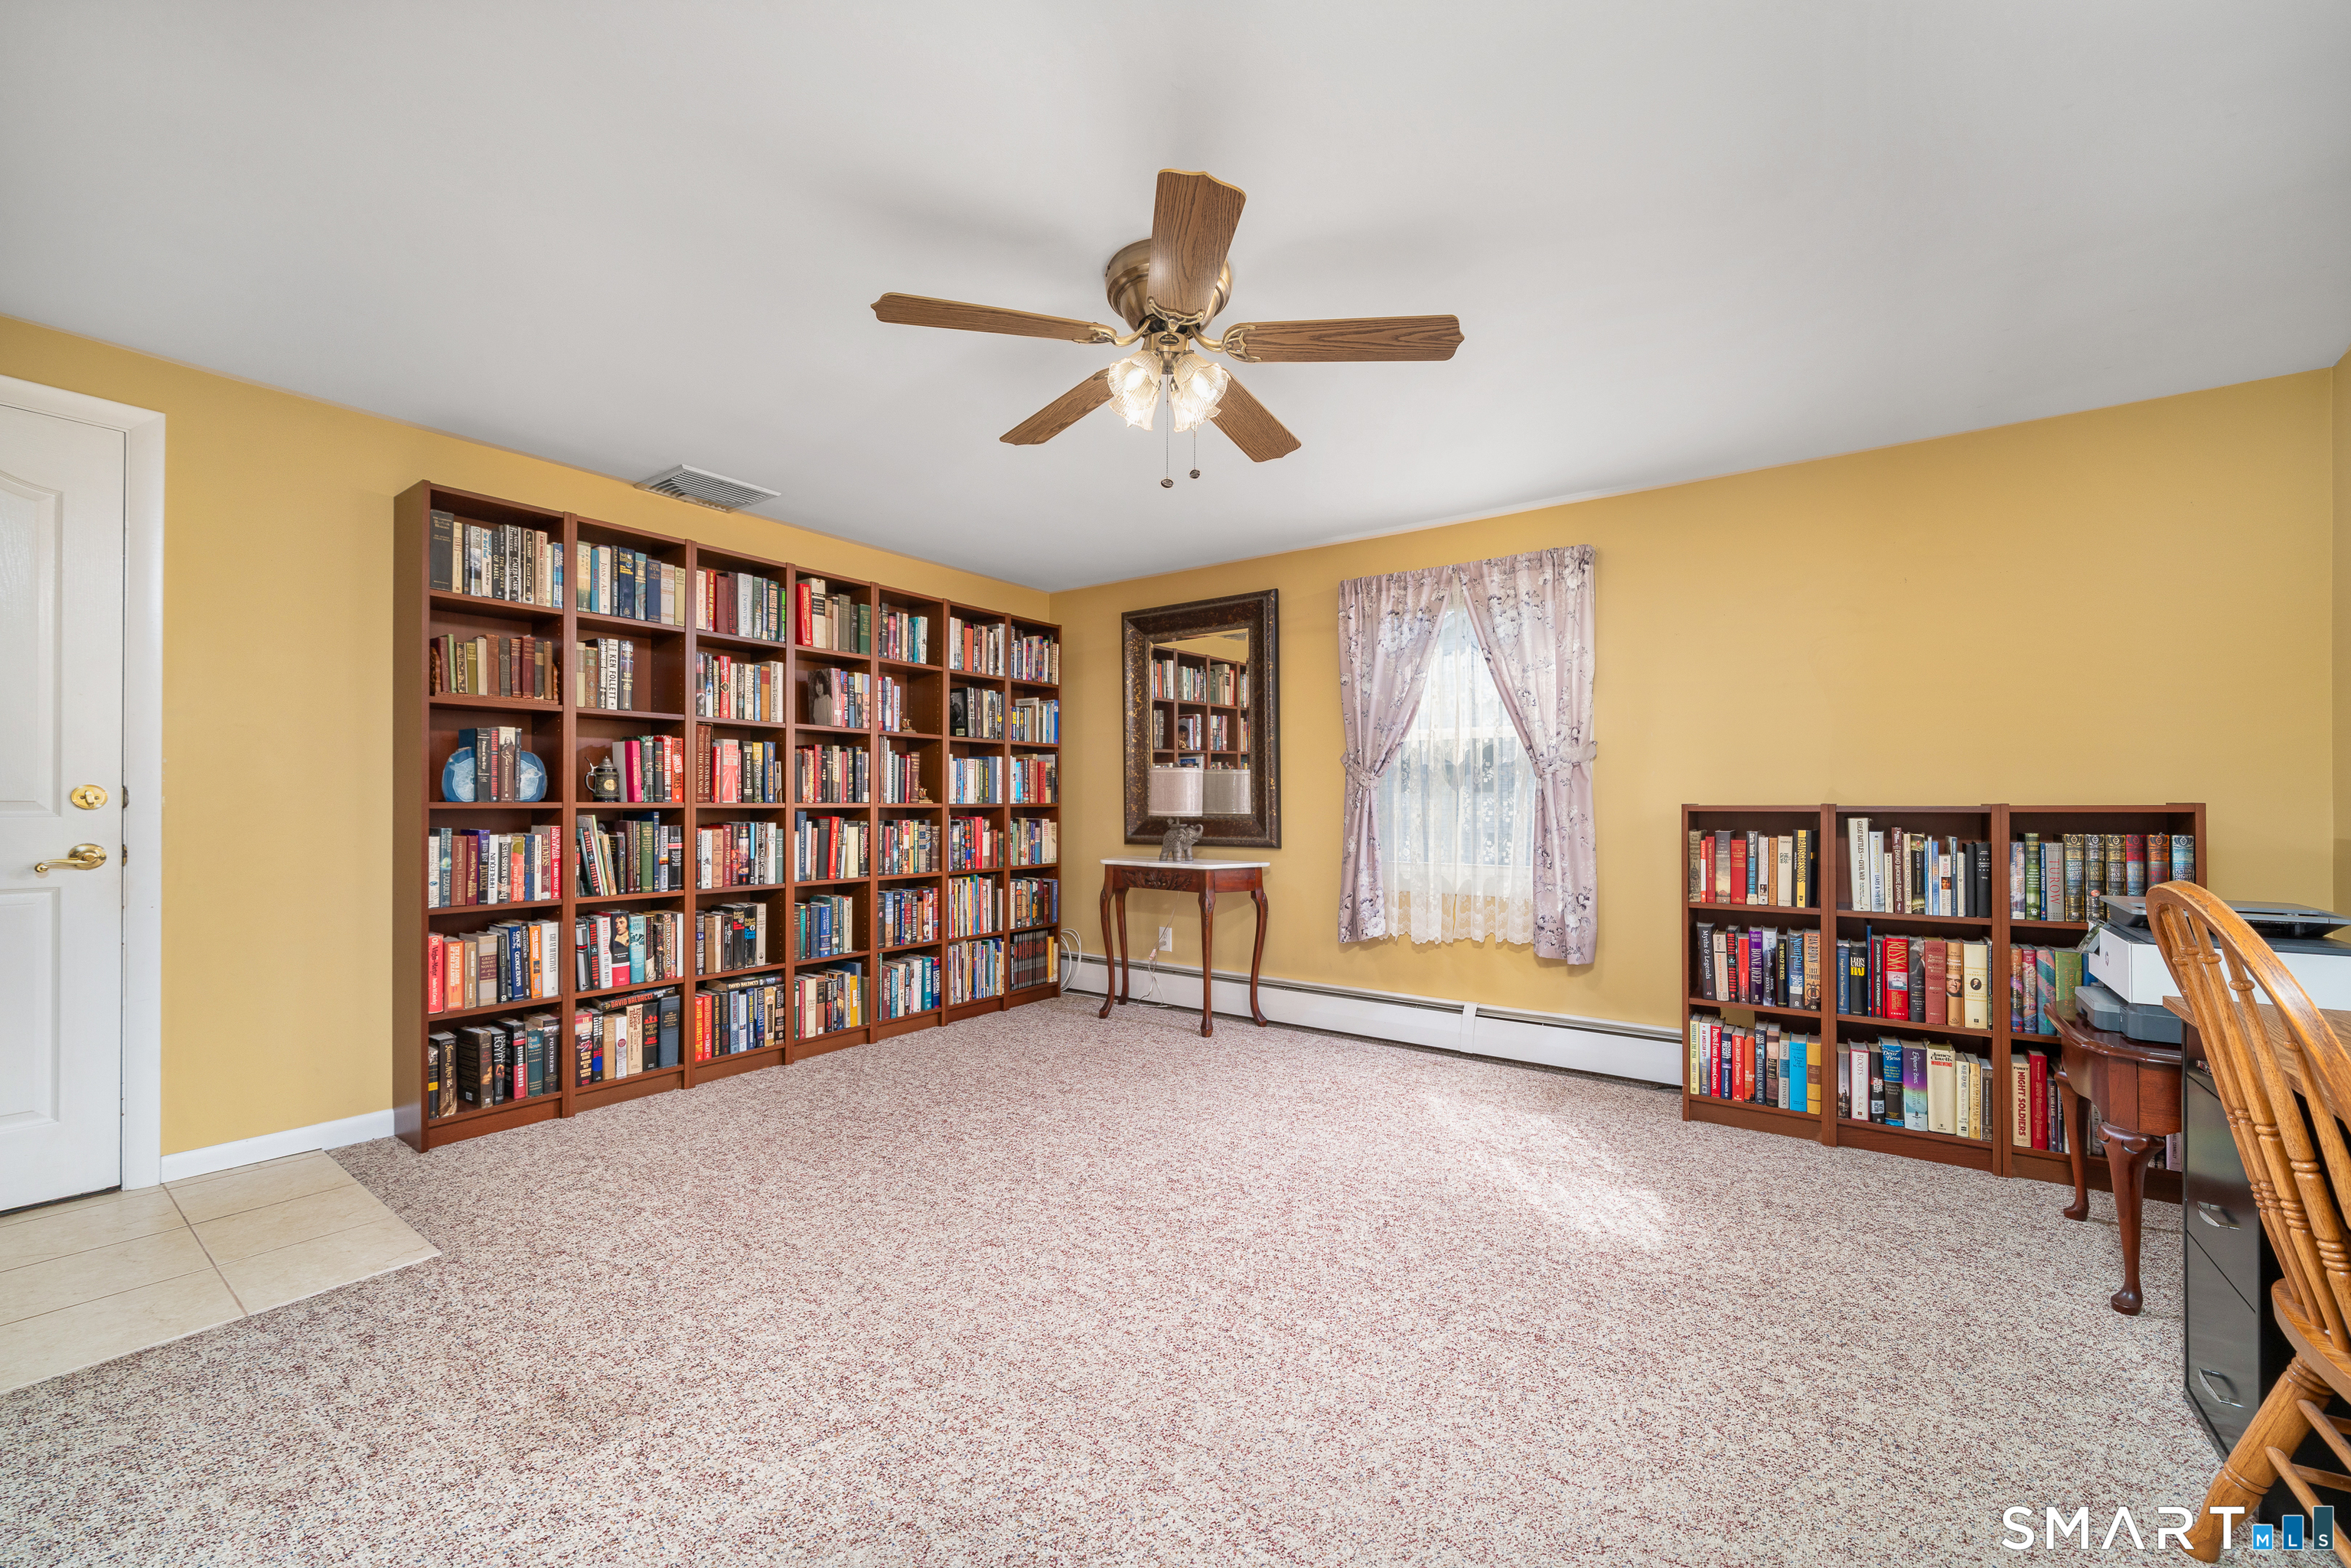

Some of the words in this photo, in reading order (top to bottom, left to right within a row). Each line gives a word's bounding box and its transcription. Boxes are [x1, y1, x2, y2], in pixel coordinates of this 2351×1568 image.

[584, 831, 592, 852] MICHAEL
[1797, 838, 1806, 883] TRANSGRESSIONS
[499, 878, 508, 899] Proteus
[2049, 859, 2060, 904] TUROW
[1808, 935, 1818, 945] DAN
[1751, 948, 1762, 966] BONE
[1808, 947, 1818, 963] BROWN
[1887, 941, 1907, 970] RUSSKA
[1703, 956, 1712, 979] Legends
[1751, 967, 1762, 984] DEEP
[628, 994, 653, 1004] BALDACCI
[2017, 1072, 2026, 1096] NIGHT
[2018, 1098, 2027, 1136] SOLDIERS
